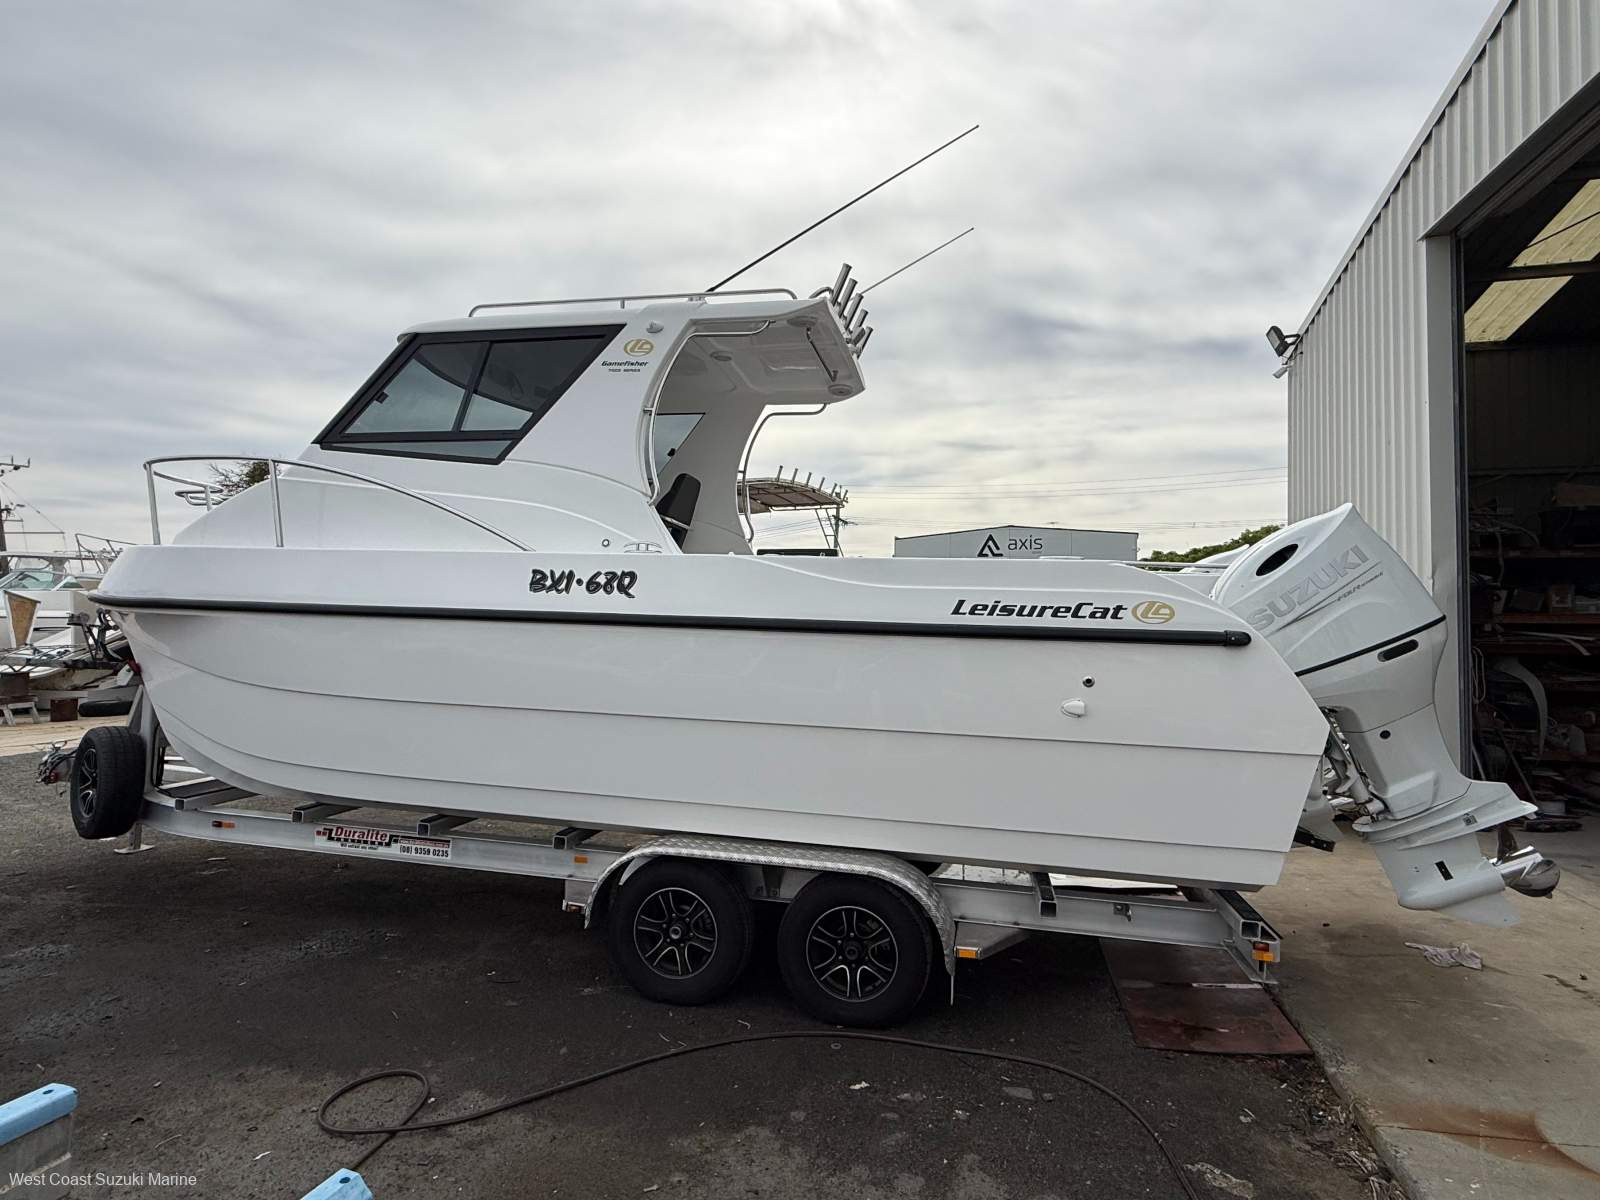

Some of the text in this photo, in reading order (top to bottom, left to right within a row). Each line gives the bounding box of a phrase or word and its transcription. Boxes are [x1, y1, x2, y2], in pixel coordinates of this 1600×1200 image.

[1007, 534, 1043, 551] axis
[1248, 545, 1369, 631] SUZUKI
[951, 599, 1128, 621] LeisureCat
[335, 827, 388, 842] Duralite
[414, 846, 431, 856] 9359
[432, 848, 449, 858] 0235
